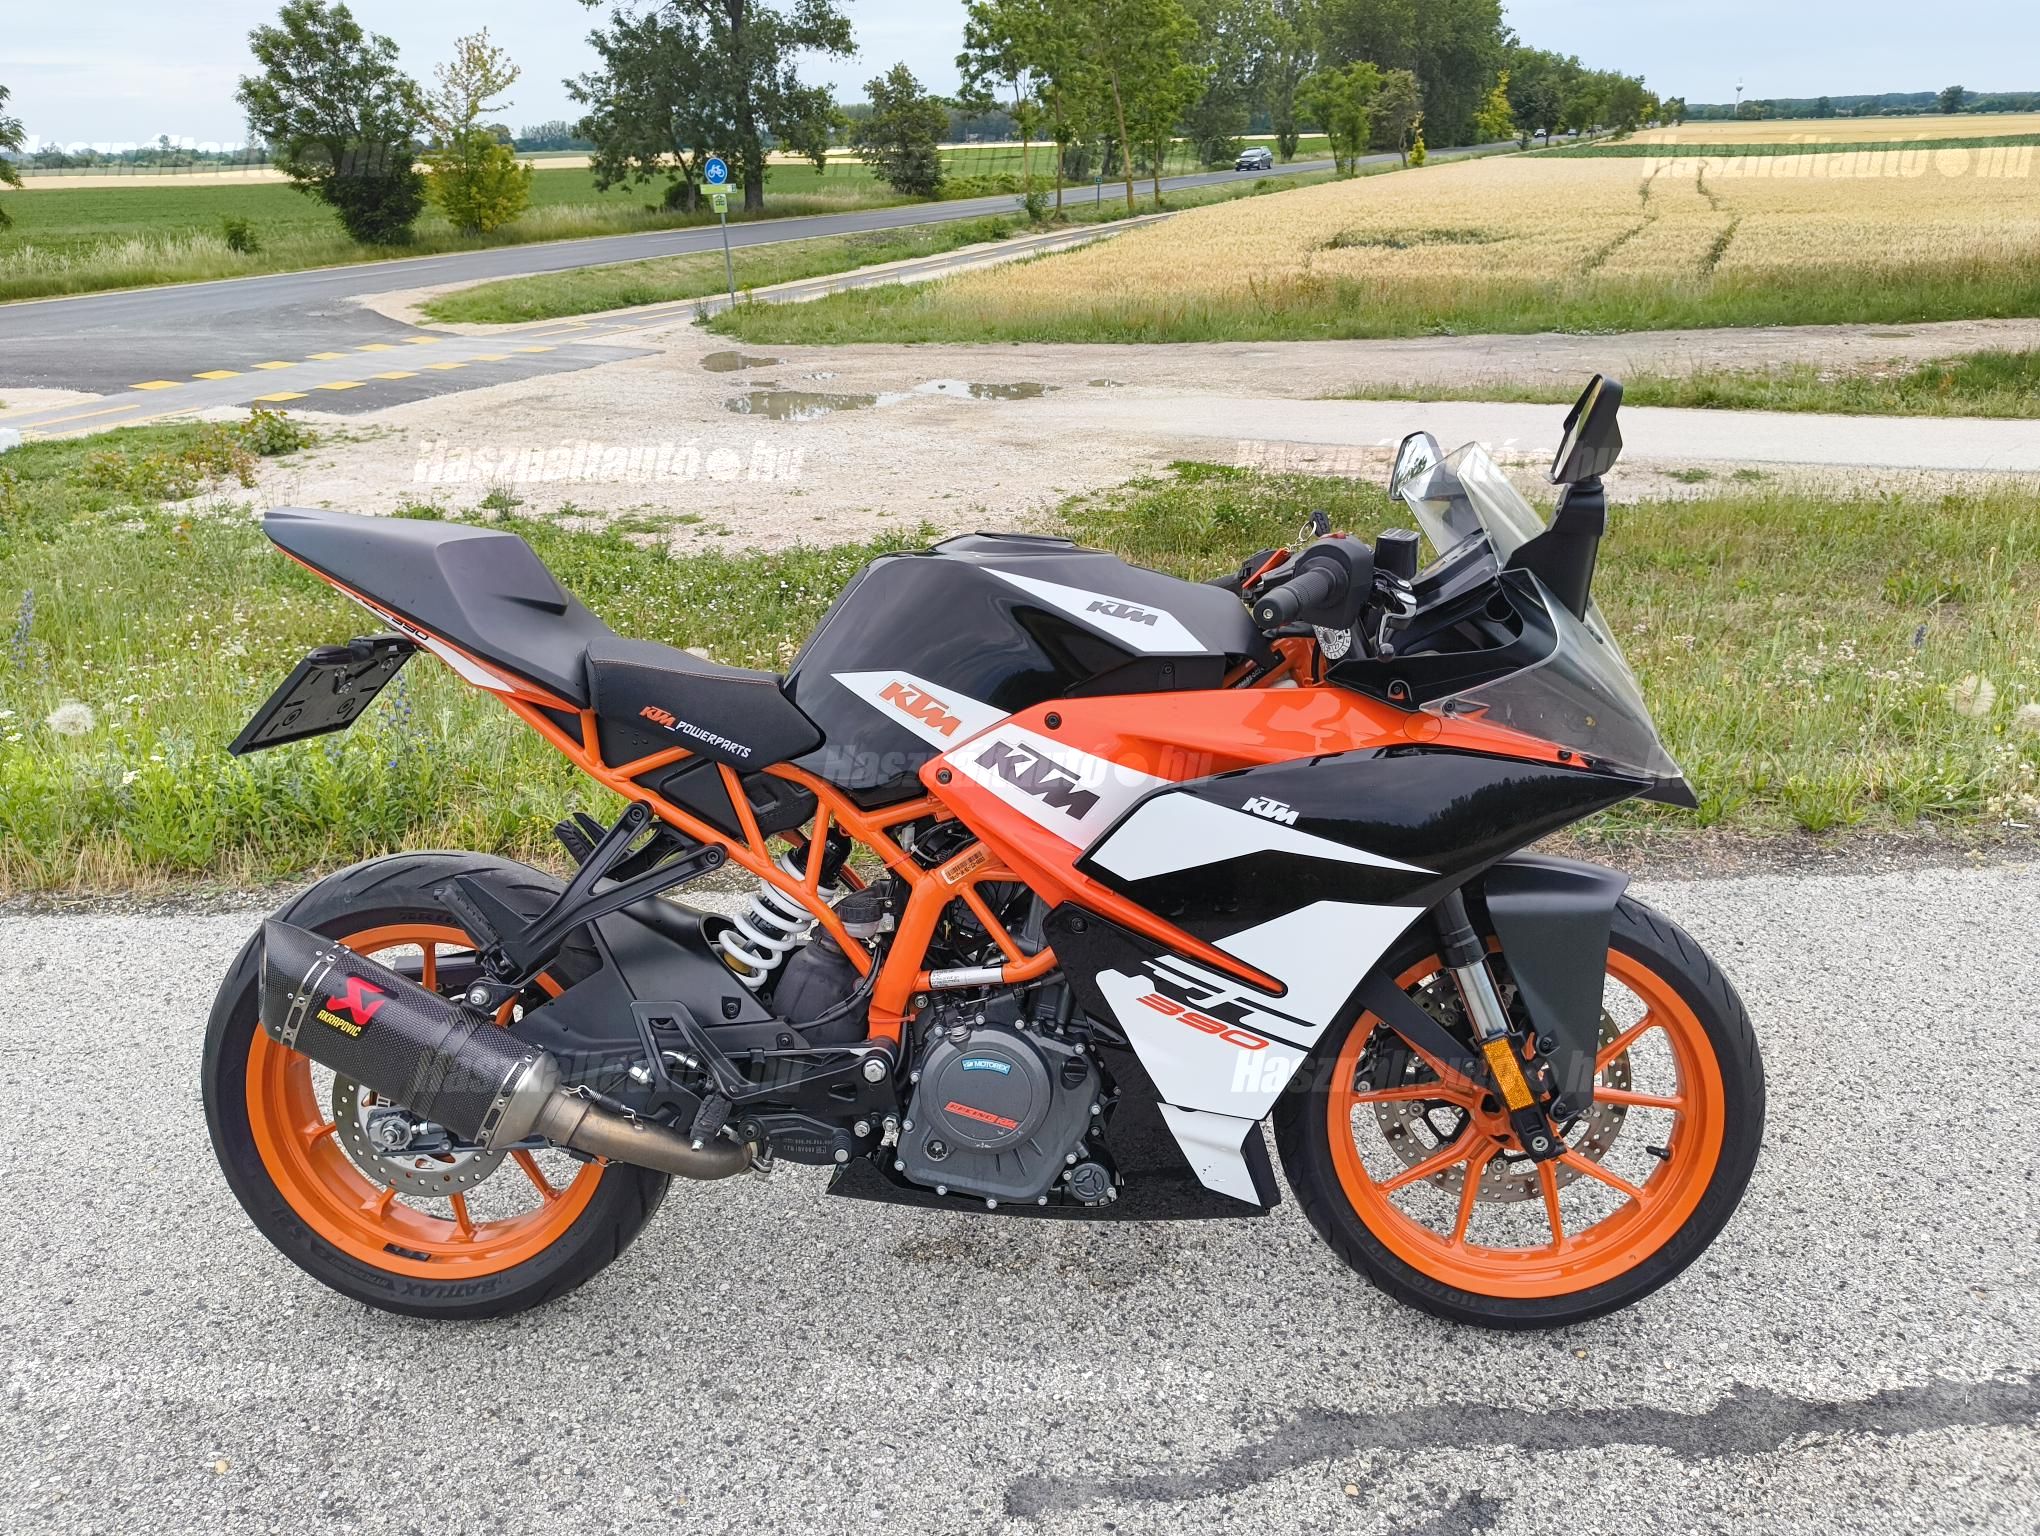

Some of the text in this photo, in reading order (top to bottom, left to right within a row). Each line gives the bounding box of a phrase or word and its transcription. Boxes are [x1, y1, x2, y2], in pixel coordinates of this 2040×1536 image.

[1086, 600, 1159, 627] KTM
[640, 705, 752, 759] KTM POWERPARTS
[879, 681, 962, 737] KTM
[973, 740, 1101, 821] KTM
[1241, 796, 1300, 825] KTM
[1136, 993, 1270, 1050] 390
